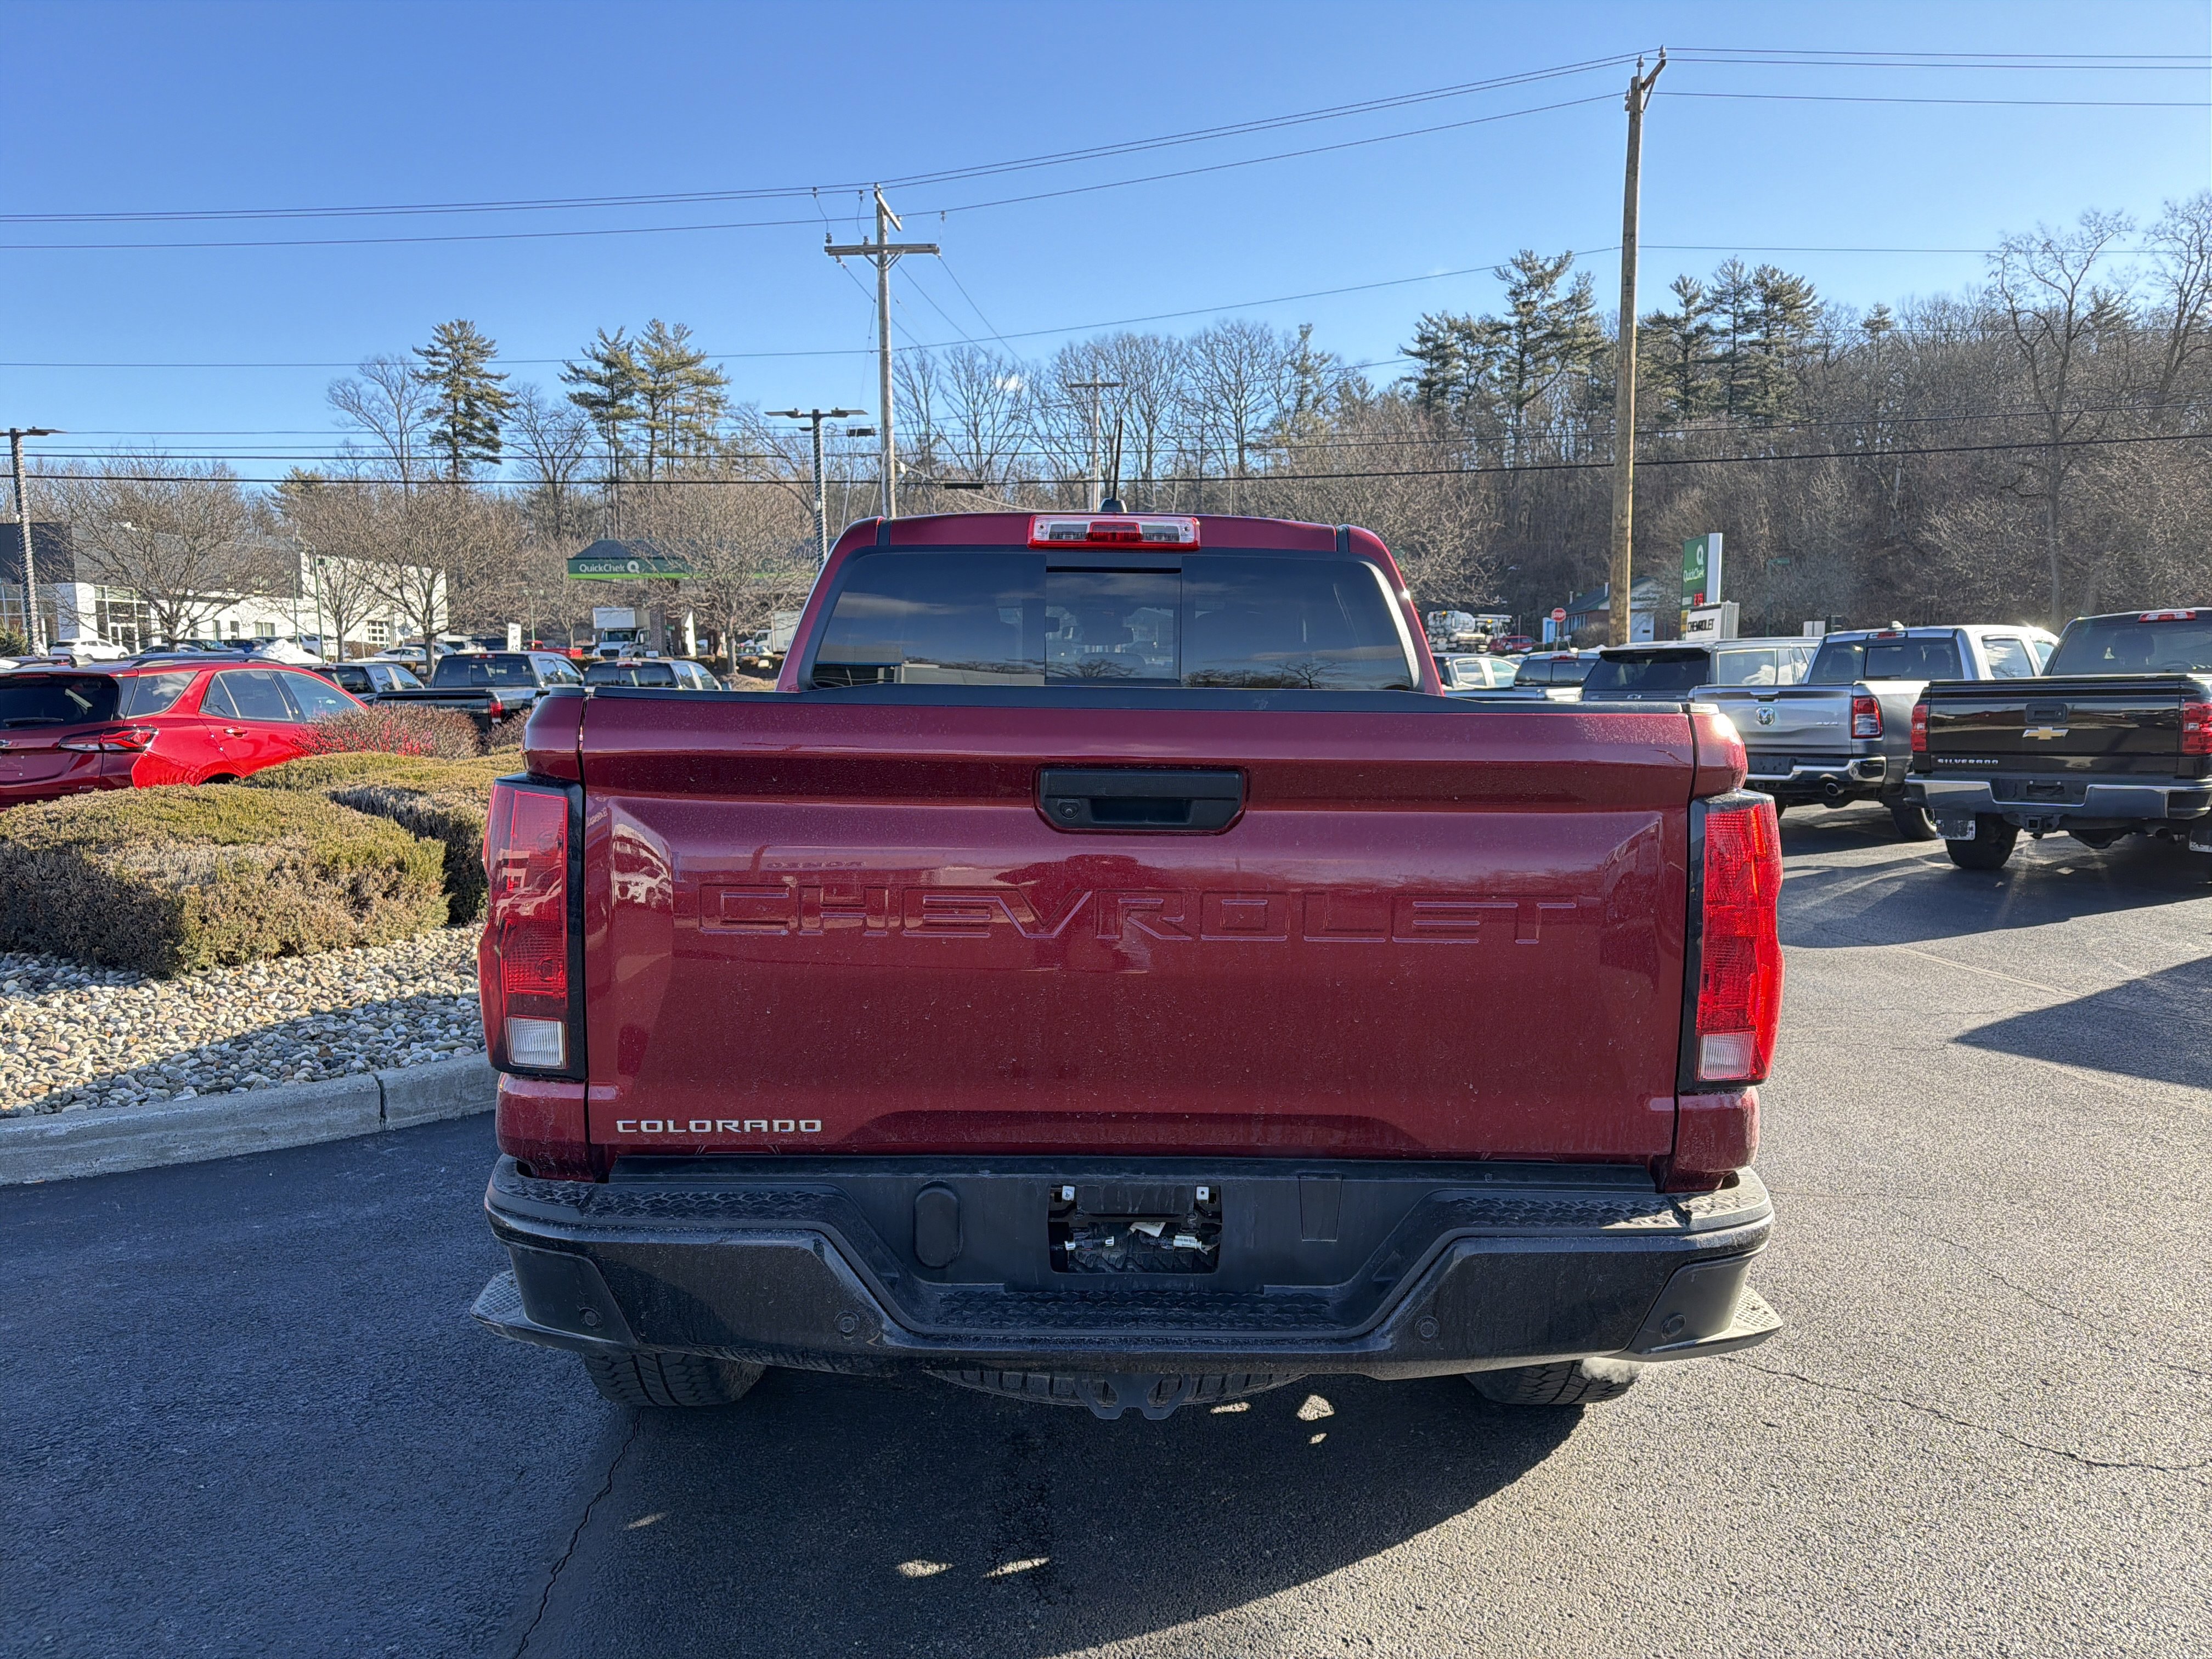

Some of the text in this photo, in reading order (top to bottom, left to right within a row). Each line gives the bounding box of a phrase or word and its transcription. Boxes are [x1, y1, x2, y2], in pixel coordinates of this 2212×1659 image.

[579, 563, 625, 573] QuickChek
[1683, 566, 1705, 583] QuickChek
[1688, 618, 1714, 633] CHEVROLET
[698, 883, 1577, 944] CHEVROLET
[616, 1119, 822, 1133] COLORADO
